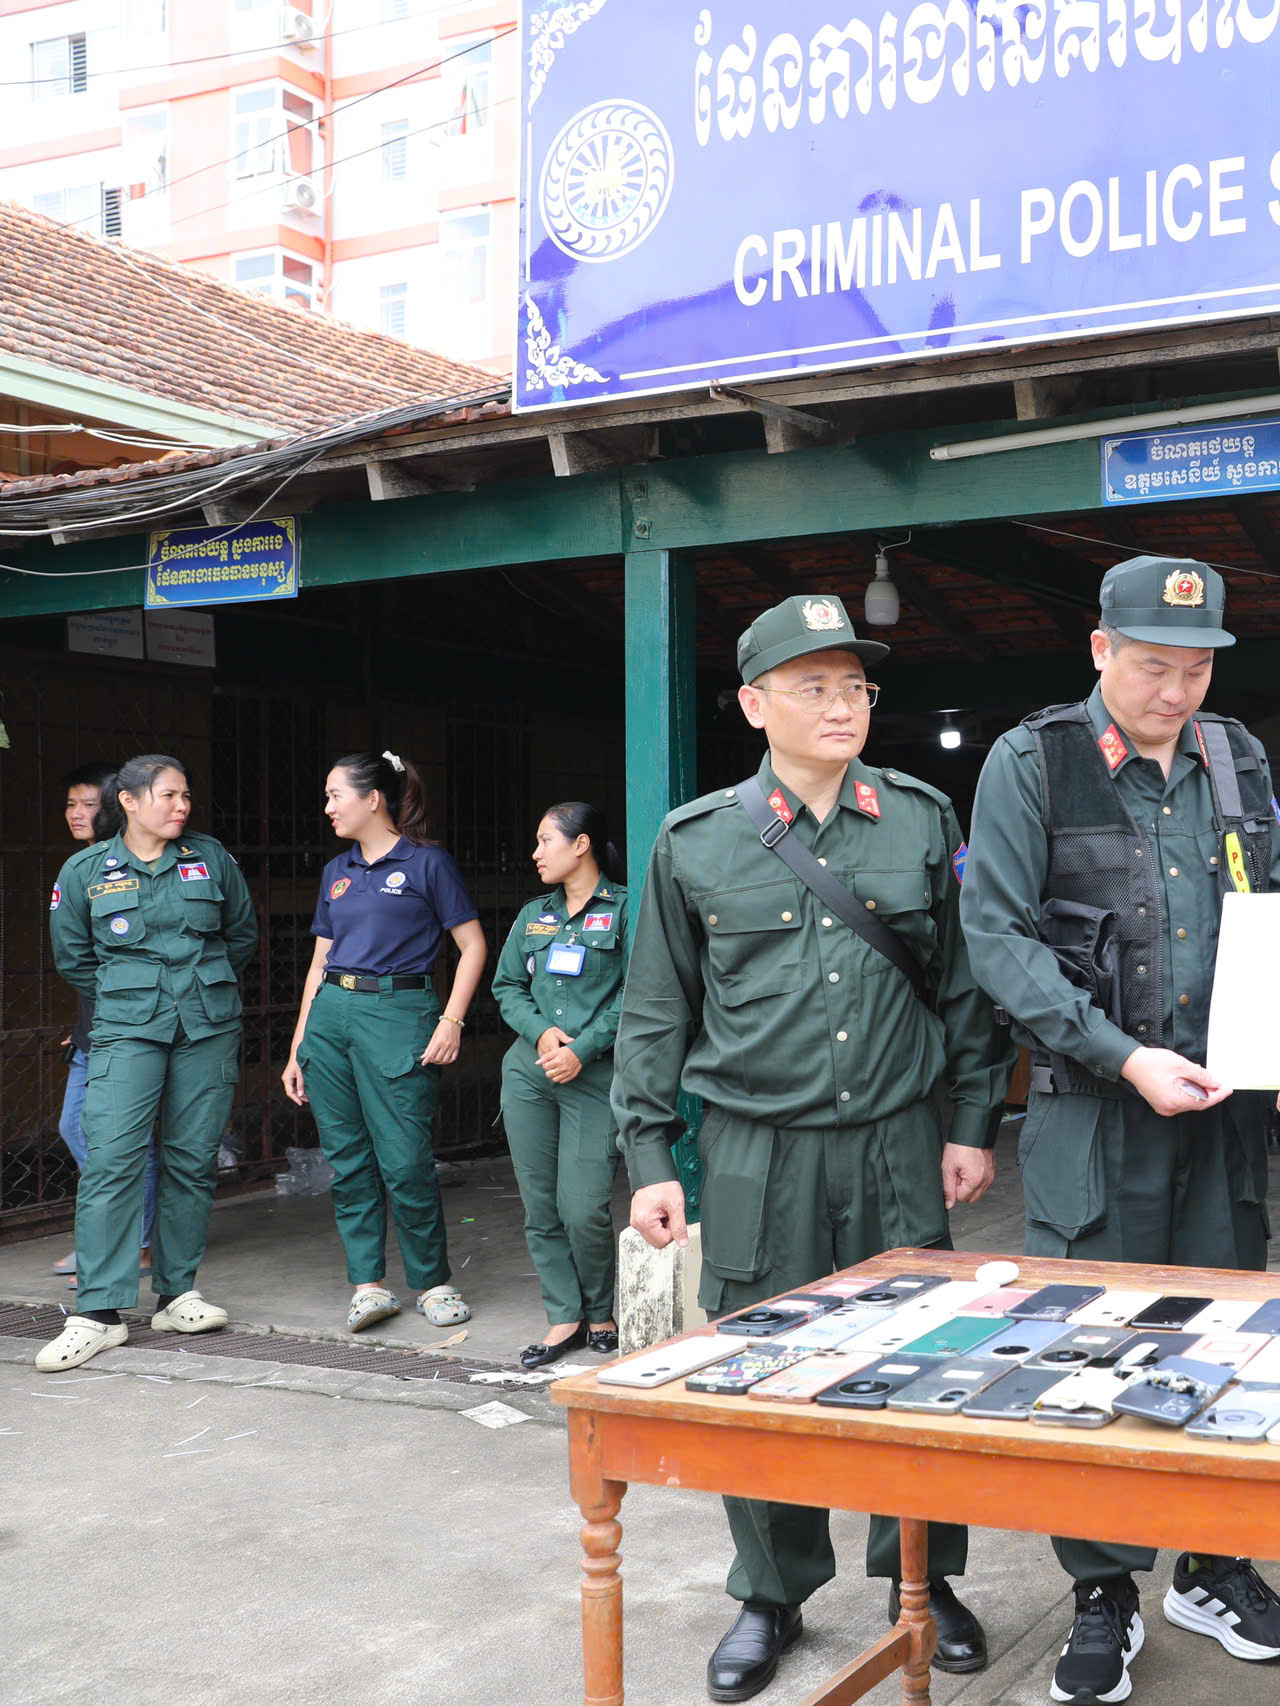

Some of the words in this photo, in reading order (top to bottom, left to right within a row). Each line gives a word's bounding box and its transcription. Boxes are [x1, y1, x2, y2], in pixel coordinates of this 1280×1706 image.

[733, 198, 1001, 306] CRIMINAL
[1020, 154, 1246, 264] POLICE
[380, 887, 402, 895] POLICE
